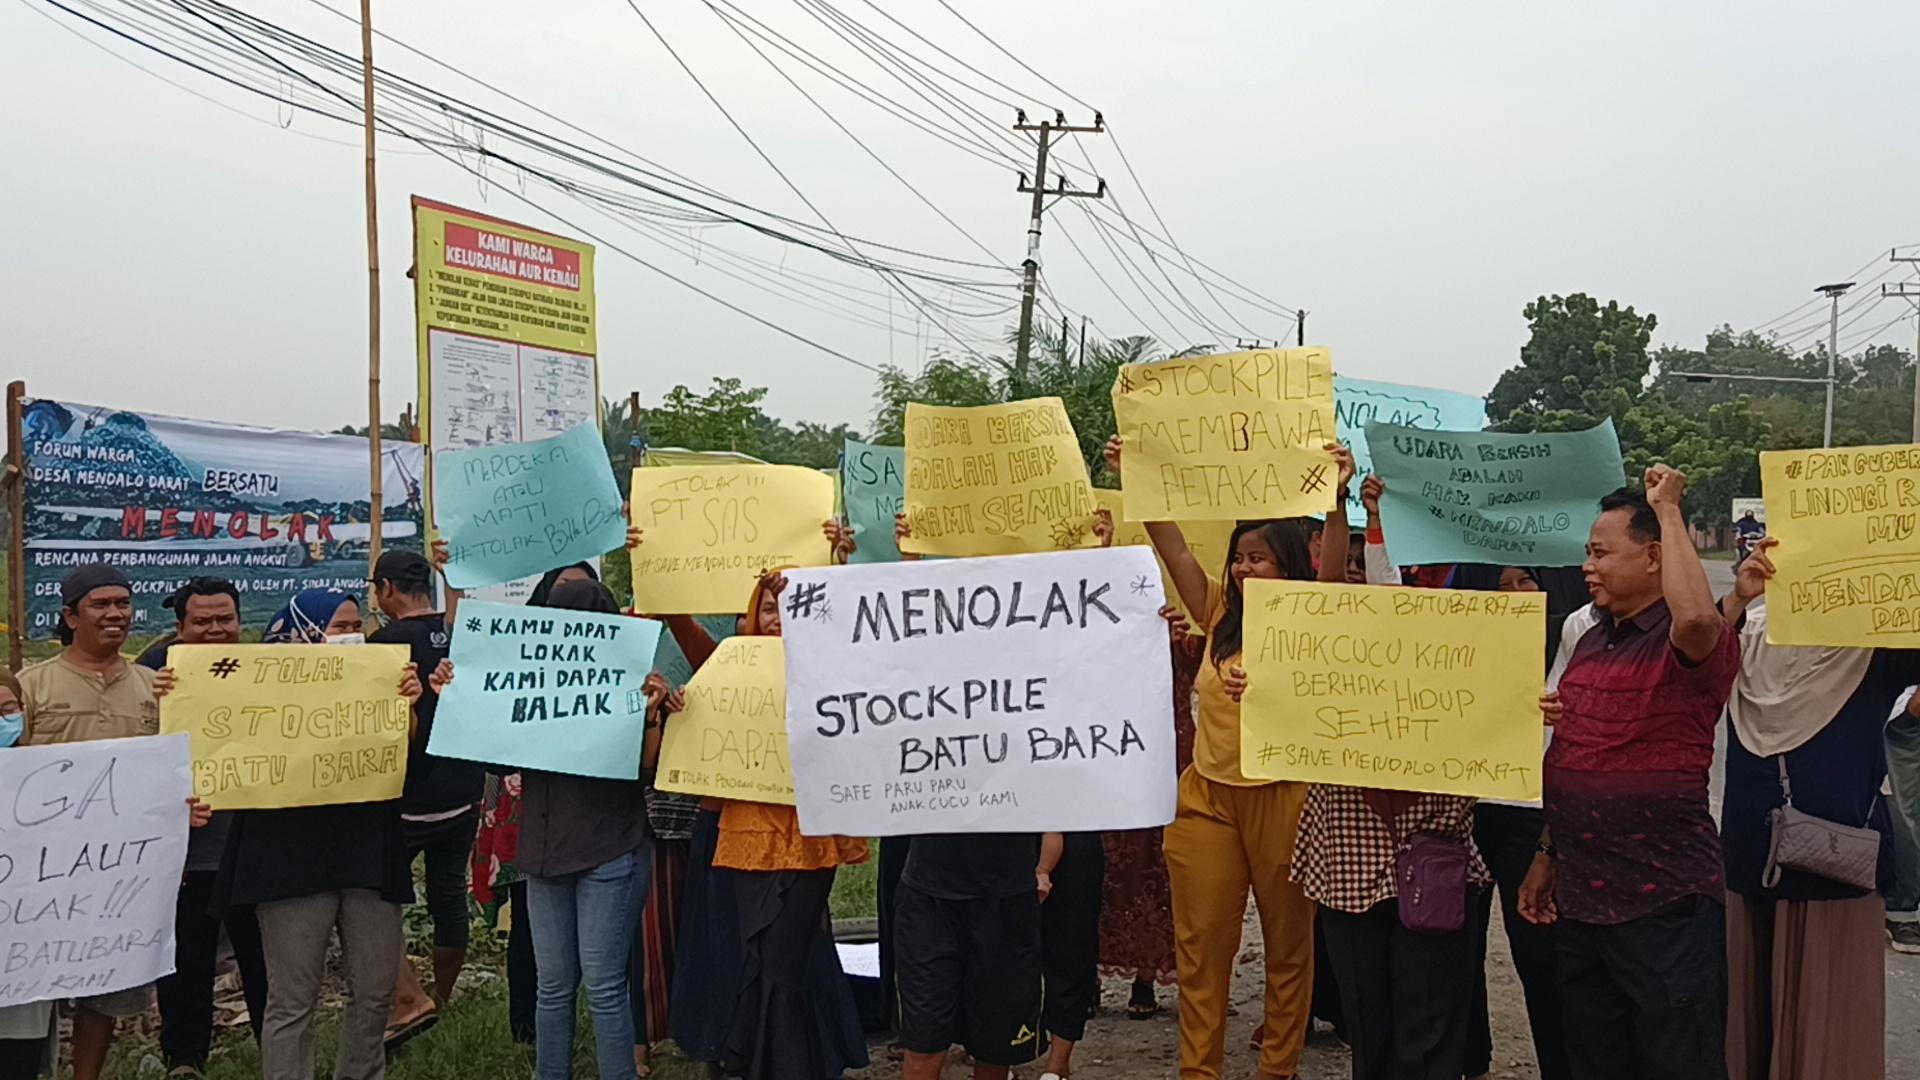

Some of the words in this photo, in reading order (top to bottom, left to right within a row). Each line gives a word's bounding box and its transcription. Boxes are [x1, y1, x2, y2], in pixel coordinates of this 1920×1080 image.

[446, 246, 516, 276] KELURAHAN
[519, 260, 541, 279] AUR
[478, 231, 510, 251] KAMI
[512, 237, 554, 264] WARGA
[1139, 409, 1326, 454] MEMBAWA
[34, 441, 83, 460] FORUM
[86, 445, 136, 463] WARGA
[1008, 445, 1059, 484] HAK
[34, 468, 72, 484] DESA
[76, 470, 144, 487] MENDALO
[148, 475, 191, 491] DARAT
[203, 470, 280, 495] BERSATU
[659, 474, 740, 493] TOLAK
[1160, 463, 1287, 512] PETAKA
[473, 501, 547, 527] MATI
[650, 497, 690, 528] PT
[703, 496, 760, 547] SAS
[910, 504, 975, 540] KAMI
[982, 480, 1091, 536] SEMUA
[35, 552, 99, 567] RENCANA
[103, 552, 200, 568] PEMBANGUNAN
[204, 553, 241, 567] JALAN
[245, 553, 287, 568] ANGKUT
[448, 535, 543, 564] #TOLAK
[684, 554, 740, 574] MENDALO
[253, 579, 279, 591] OLEH
[851, 579, 1121, 643] MENOLAK
[490, 618, 555, 636] KAMU
[564, 622, 621, 640] DAPAT
[520, 643, 596, 663] LOKAK
[1416, 643, 1476, 670] KAMI
[556, 668, 627, 688] DAPAT
[1292, 670, 1388, 698] BERHAK
[1394, 678, 1475, 718] HIDUP
[202, 699, 407, 739] STOCKPILE
[511, 692, 612, 723] BALAK
[815, 677, 1048, 739] STOCKPILE
[1314, 706, 1439, 742] SEHAT
[898, 732, 1008, 776] BATU
[1028, 719, 1146, 764] BARA
[193, 756, 286, 797] BATU
[313, 745, 400, 789] BARA
[1442, 758, 1531, 794] DARAT
[830, 783, 872, 804] SAFE
[884, 782, 923, 799] PARU
[930, 778, 966, 794] PARU
[928, 796, 969, 810] CUCU
[979, 790, 1019, 807] KAMI
[38, 836, 162, 882] LAUT
[5, 929, 163, 973] BATUBARA
